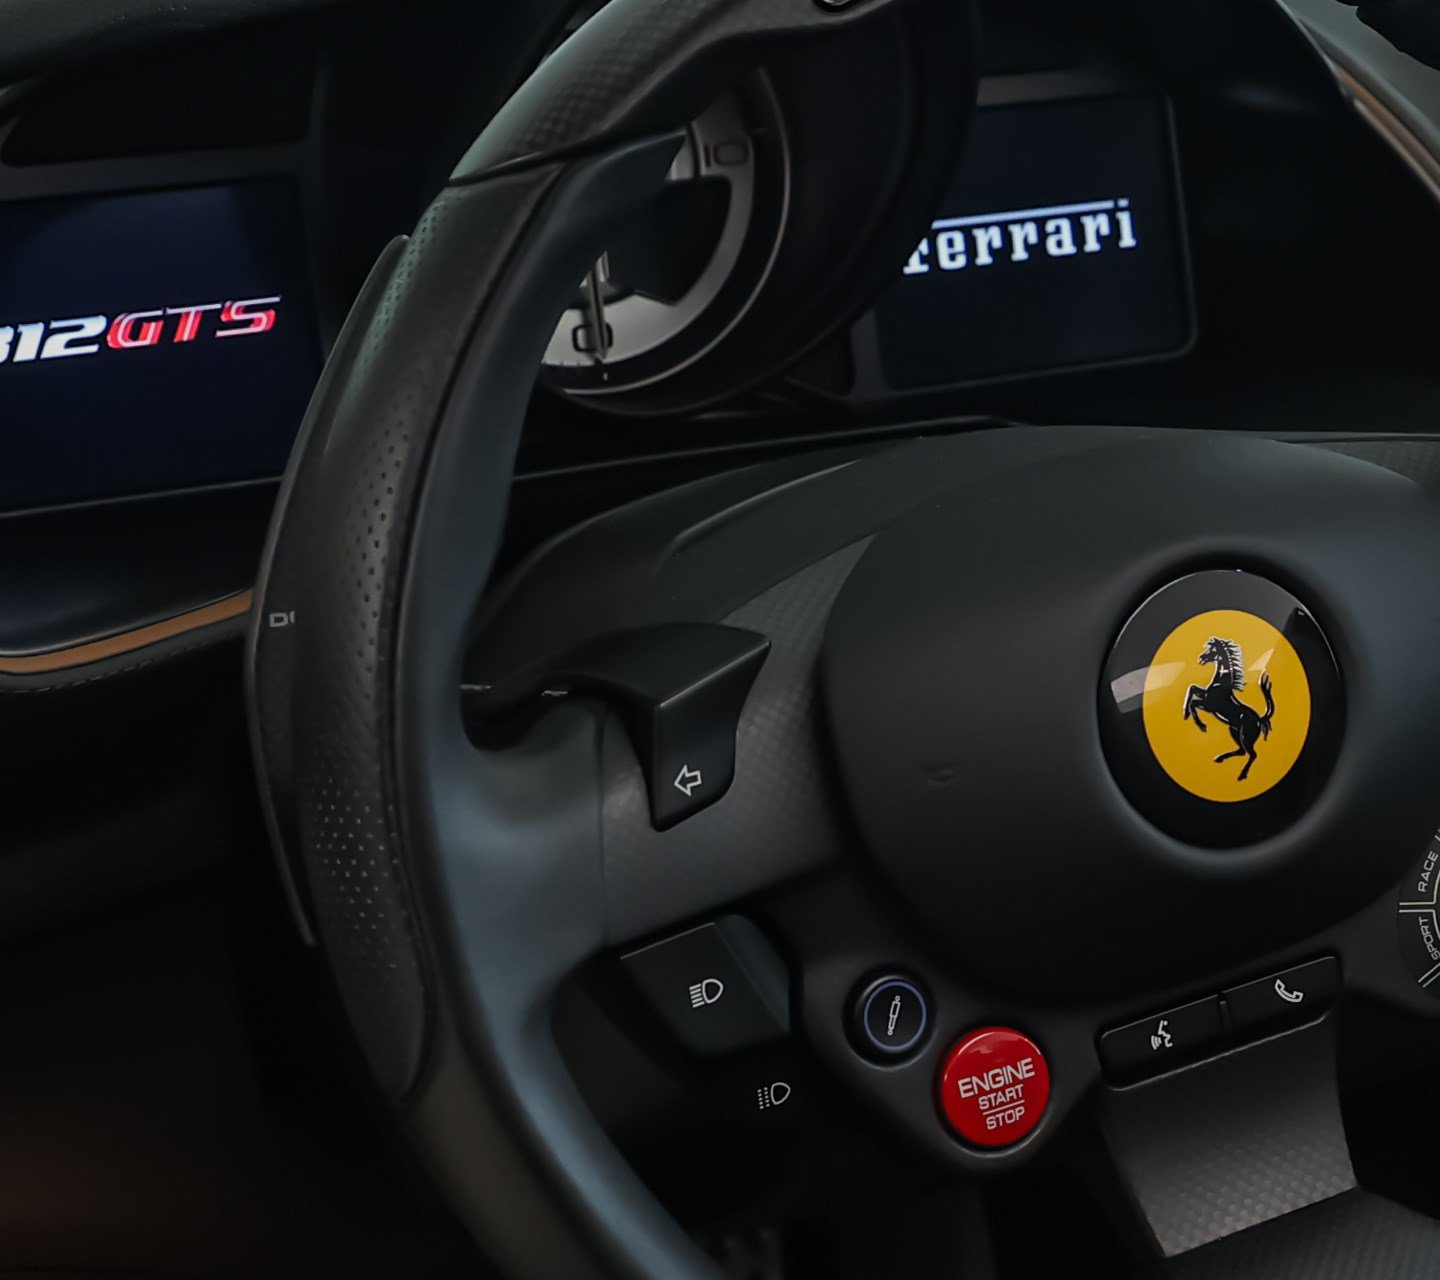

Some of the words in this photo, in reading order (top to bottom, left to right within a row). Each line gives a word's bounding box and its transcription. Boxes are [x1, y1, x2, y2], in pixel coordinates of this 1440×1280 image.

[1417, 850, 1440, 892] RACE
[957, 1057, 1036, 1099] ENGINE
[978, 1083, 1024, 1111] START
[985, 1105, 1026, 1131] STOP
